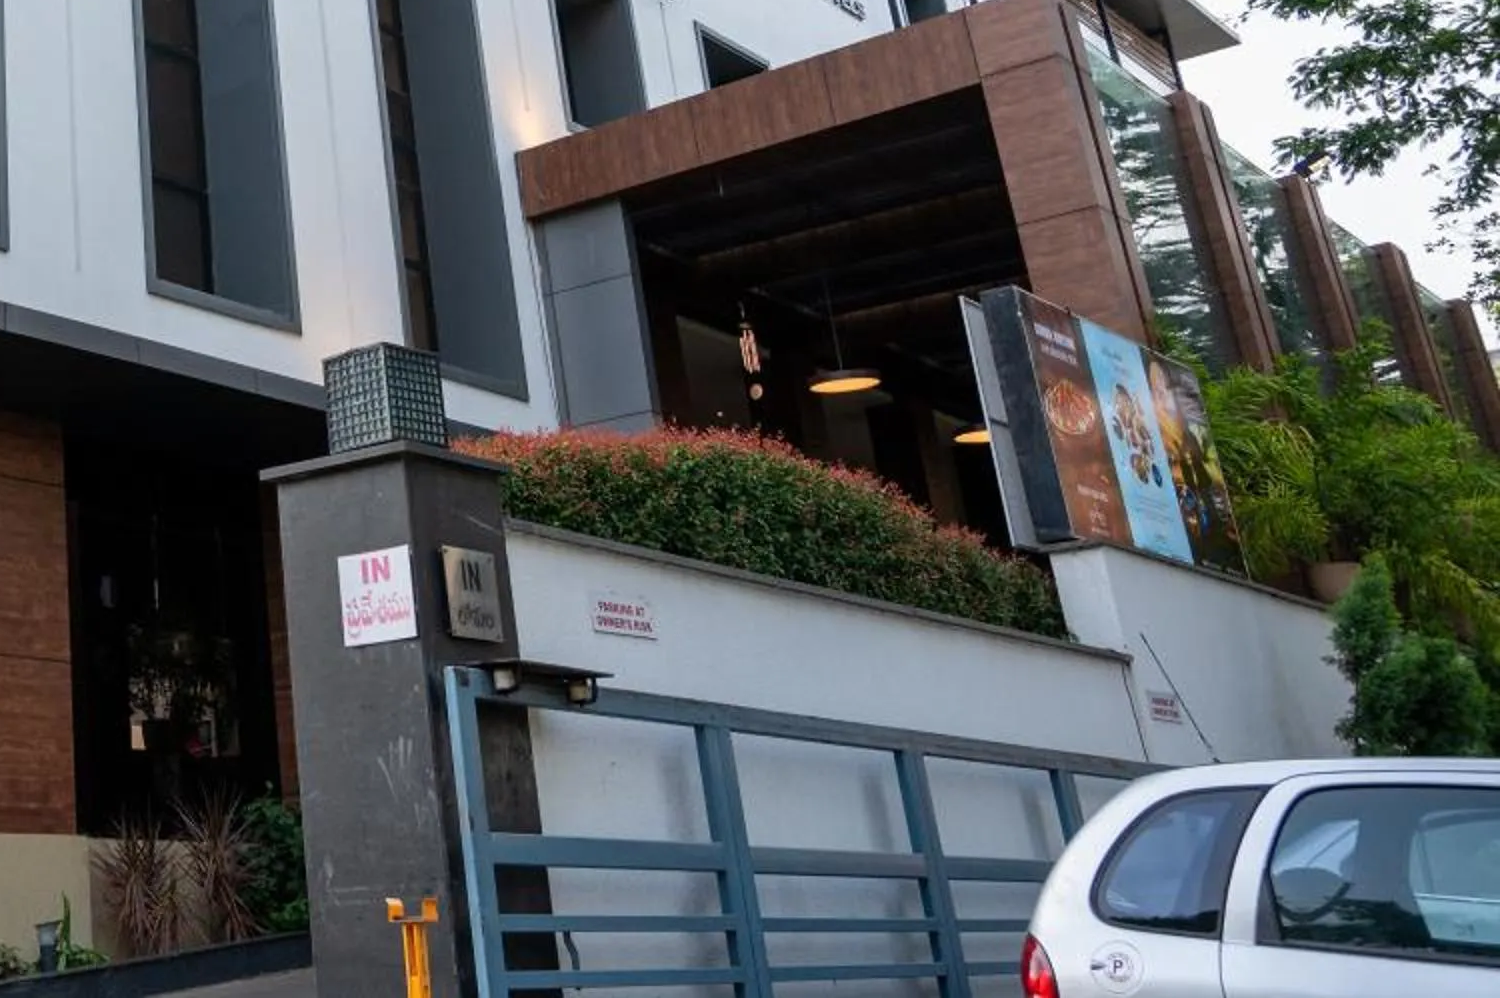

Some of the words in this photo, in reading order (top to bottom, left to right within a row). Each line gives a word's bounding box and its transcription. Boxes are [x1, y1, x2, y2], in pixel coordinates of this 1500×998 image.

[360, 555, 391, 584] IN
[460, 558, 483, 592] IN
[597, 601, 634, 617] PARKING
[635, 605, 645, 618] AT
[633, 619, 653, 633] RISK
[1113, 959, 1123, 974] P
